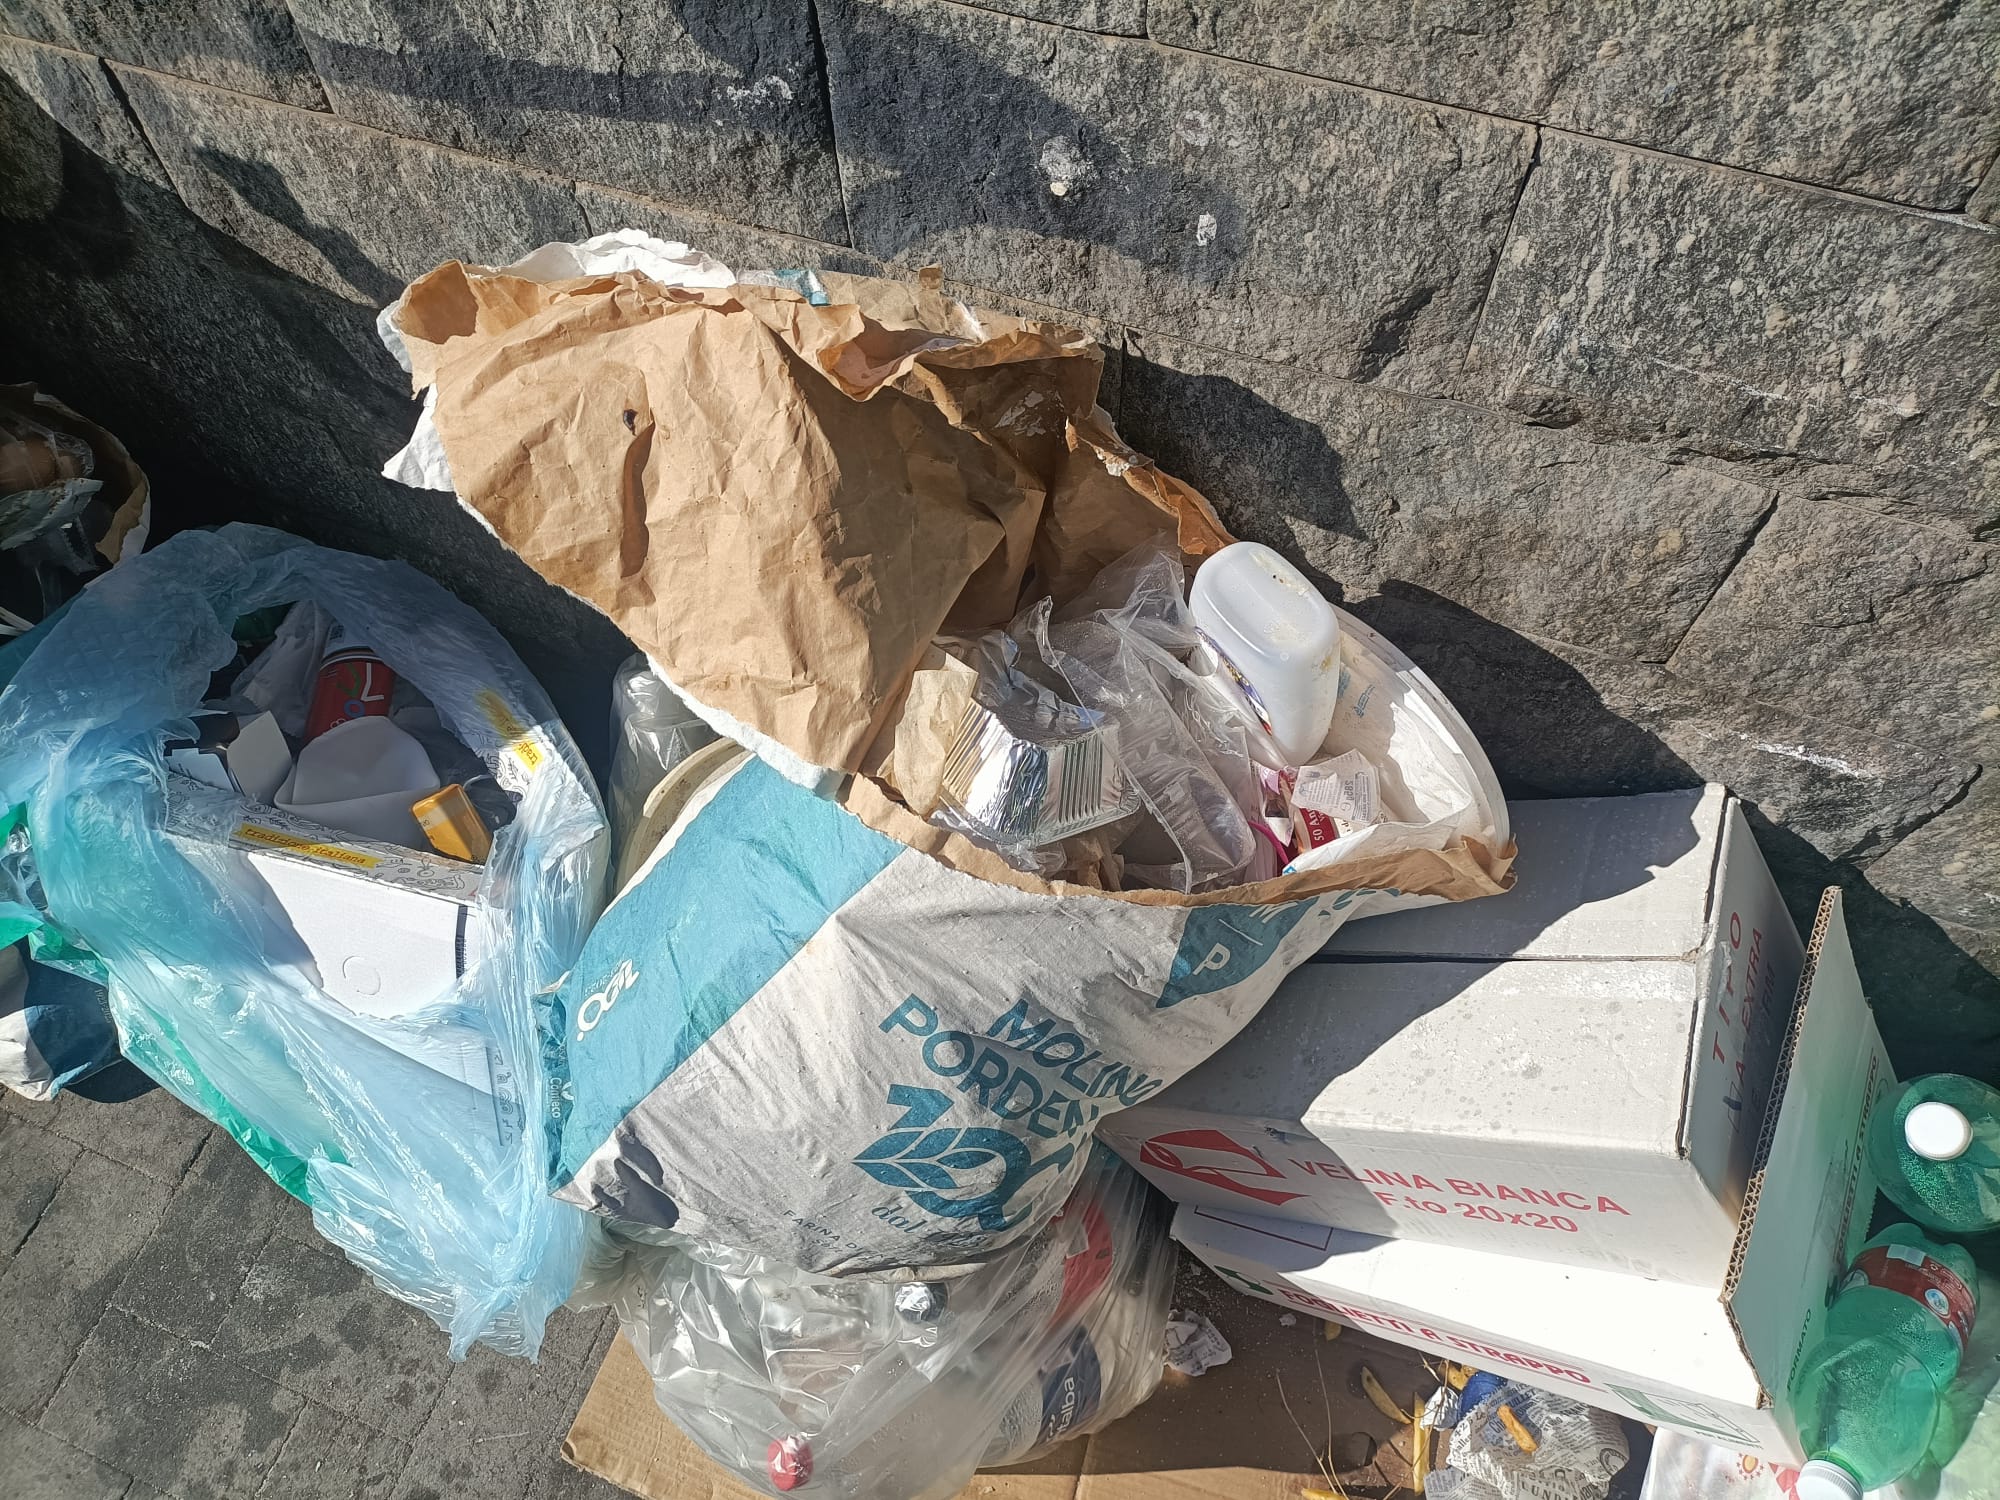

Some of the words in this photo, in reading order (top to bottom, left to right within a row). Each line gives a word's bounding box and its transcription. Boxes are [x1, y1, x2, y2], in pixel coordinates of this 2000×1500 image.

[1312, 828, 1325, 841] 50
[315, 846, 367, 865] italiana
[1193, 942, 1232, 976] P
[1288, 1157, 1443, 1192] VELINA
[1444, 1177, 1632, 1217] BIANCA
[783, 1209, 841, 1243] FARINA
[870, 1202, 929, 1235] dal
[1453, 1202, 1579, 1233] 20x20
[1278, 1288, 1415, 1334] FOGLIETTI
[1419, 1326, 1443, 1342] A
[1445, 1334, 1592, 1384] STRAPPO
[1786, 1307, 1812, 1394] FORMATO
